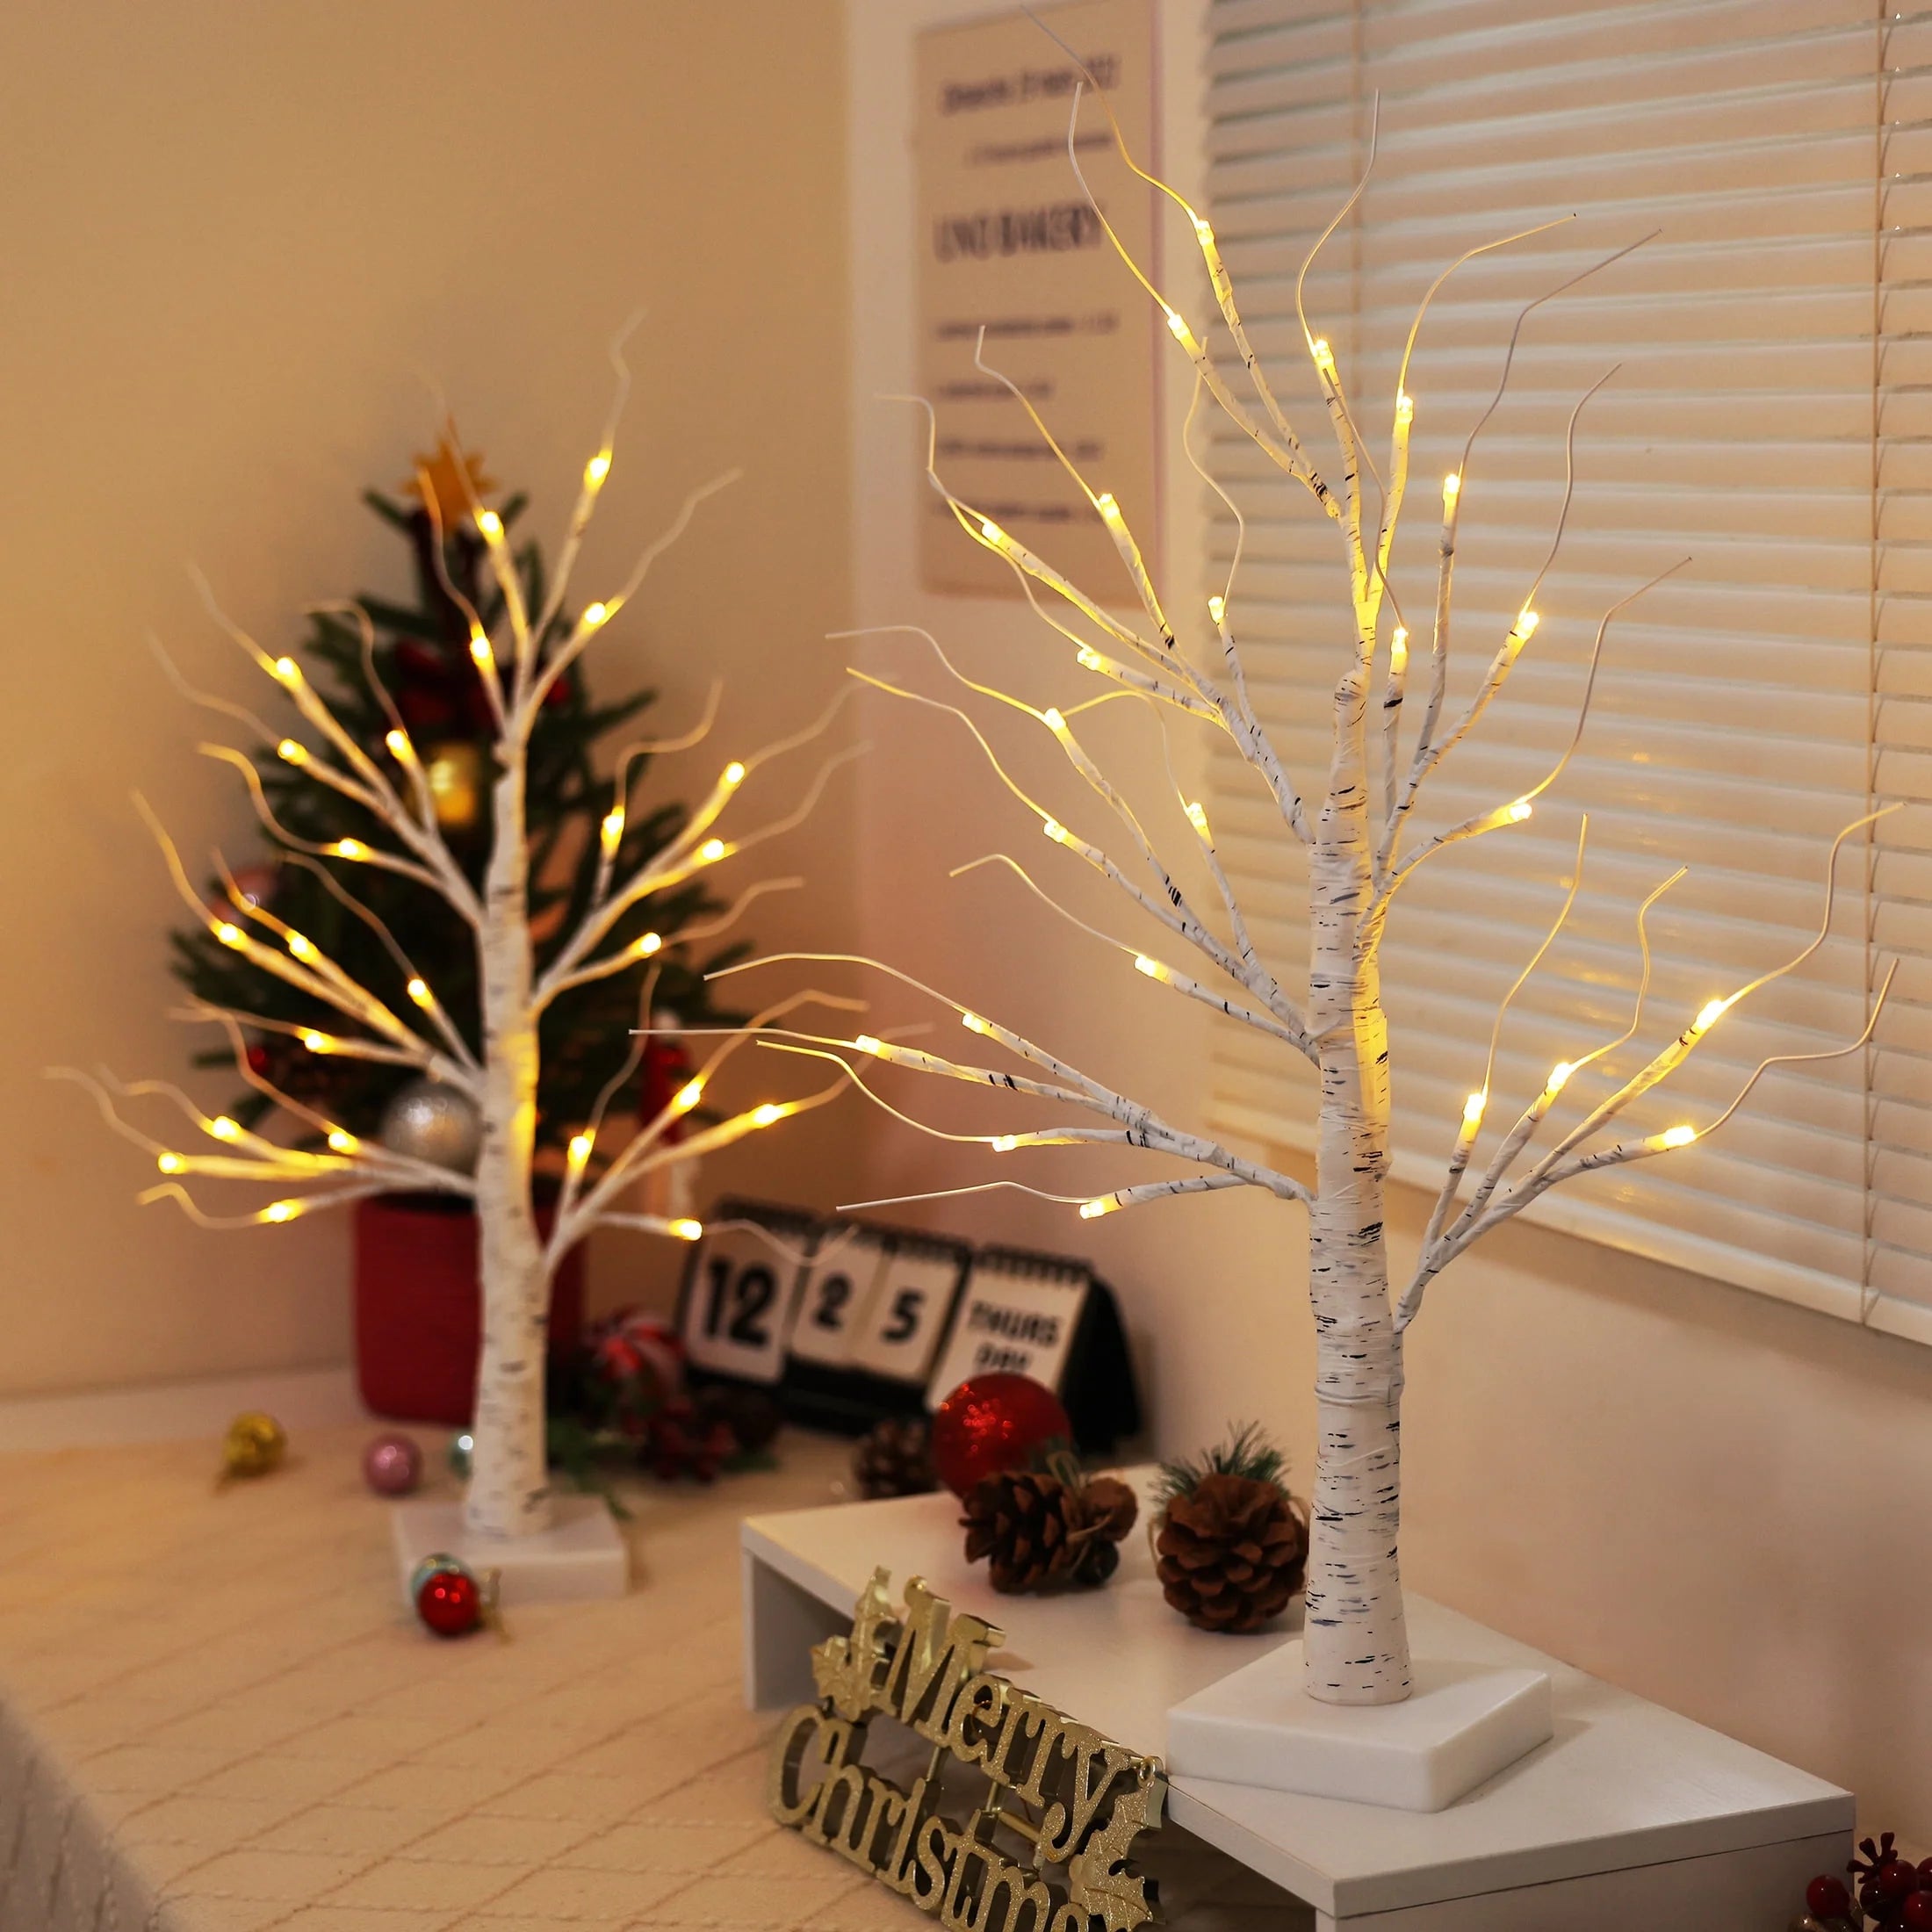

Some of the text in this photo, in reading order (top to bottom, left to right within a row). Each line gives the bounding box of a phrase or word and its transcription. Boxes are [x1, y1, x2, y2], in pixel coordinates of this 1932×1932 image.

[706, 1256, 928, 1348] 12 2 5
[870, 1575, 1133, 1864] Merry
